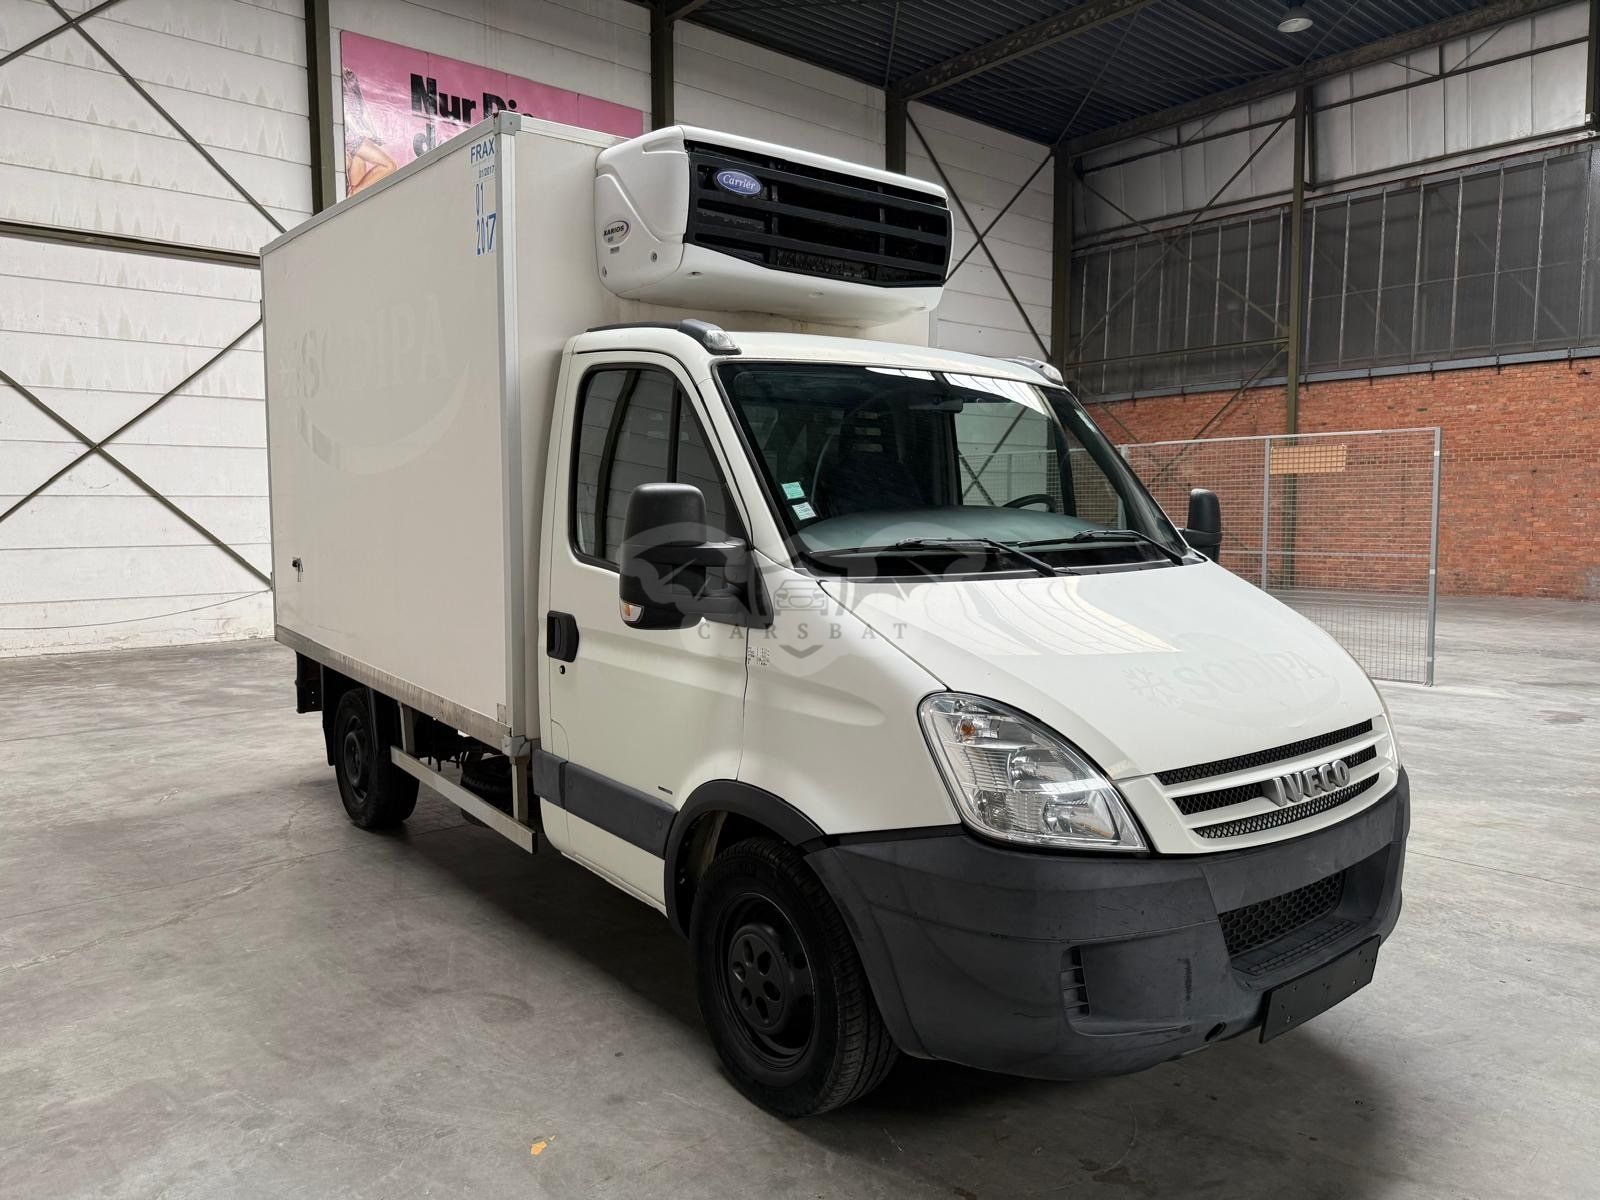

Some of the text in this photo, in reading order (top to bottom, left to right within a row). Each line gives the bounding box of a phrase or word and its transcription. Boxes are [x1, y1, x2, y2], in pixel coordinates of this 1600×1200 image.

[410, 73, 476, 124] Nur
[470, 137, 495, 164] FRAX
[723, 174, 756, 190] Carrier
[476, 213, 497, 255] 2017
[603, 224, 625, 236] XARIOS
[1271, 759, 1350, 807] IVECO
